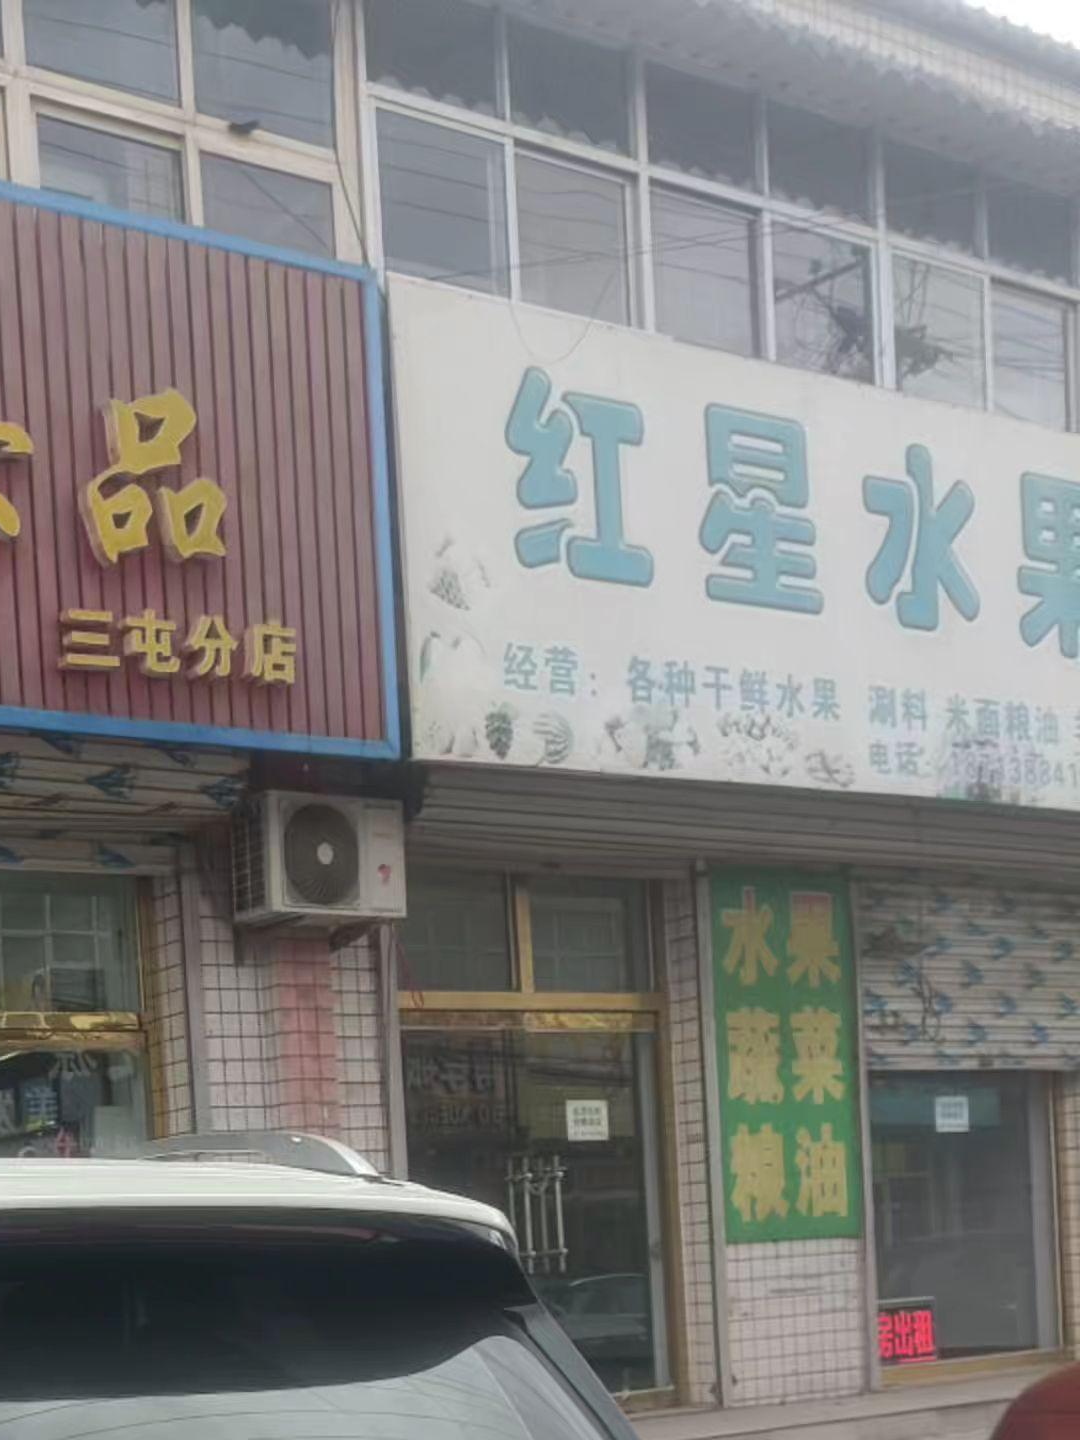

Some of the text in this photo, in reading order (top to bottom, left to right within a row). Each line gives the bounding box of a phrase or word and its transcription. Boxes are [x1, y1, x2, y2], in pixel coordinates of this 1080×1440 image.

[59, 608, 298, 688] 三屯分店
[626, 655, 842, 722] 各种干鲜水果
[721, 886, 842, 986] 水果
